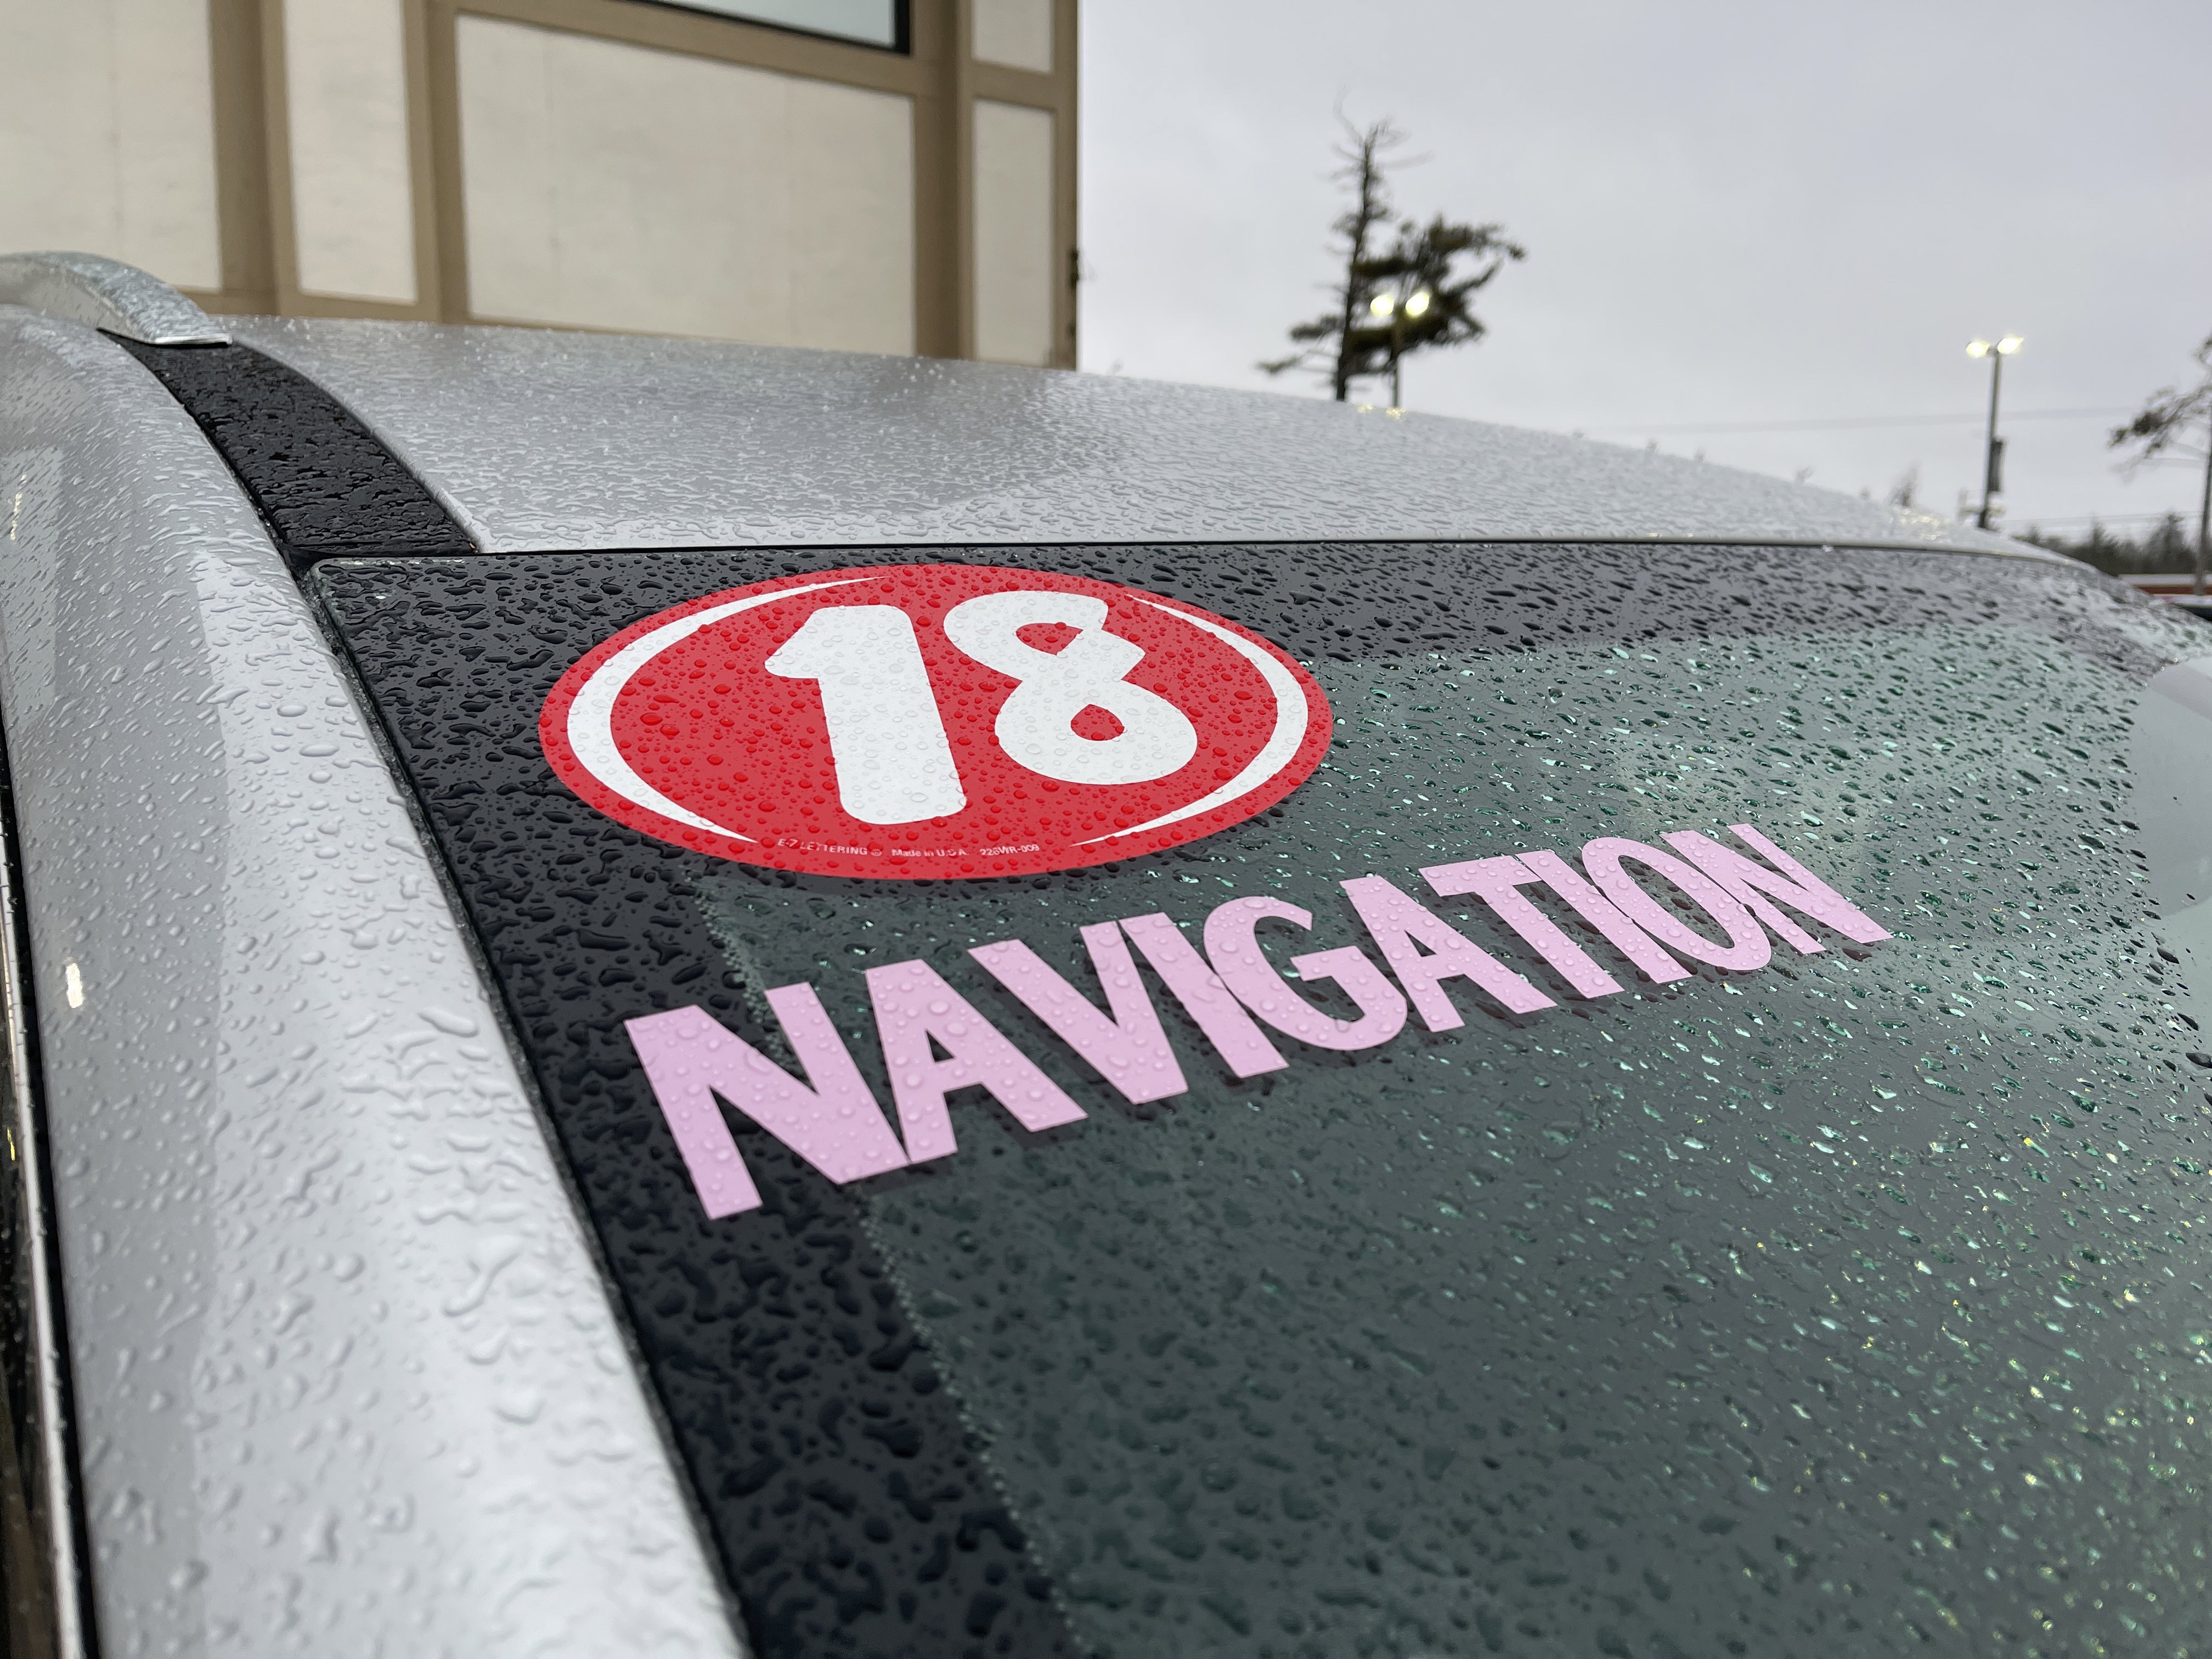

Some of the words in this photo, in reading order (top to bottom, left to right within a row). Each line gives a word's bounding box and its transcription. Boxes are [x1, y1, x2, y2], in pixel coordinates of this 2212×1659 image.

[764, 590, 1198, 826] 18
[799, 842, 868, 855] LETTERING
[891, 849, 922, 857] Made
[627, 826, 1889, 1217] NAVIGATION
